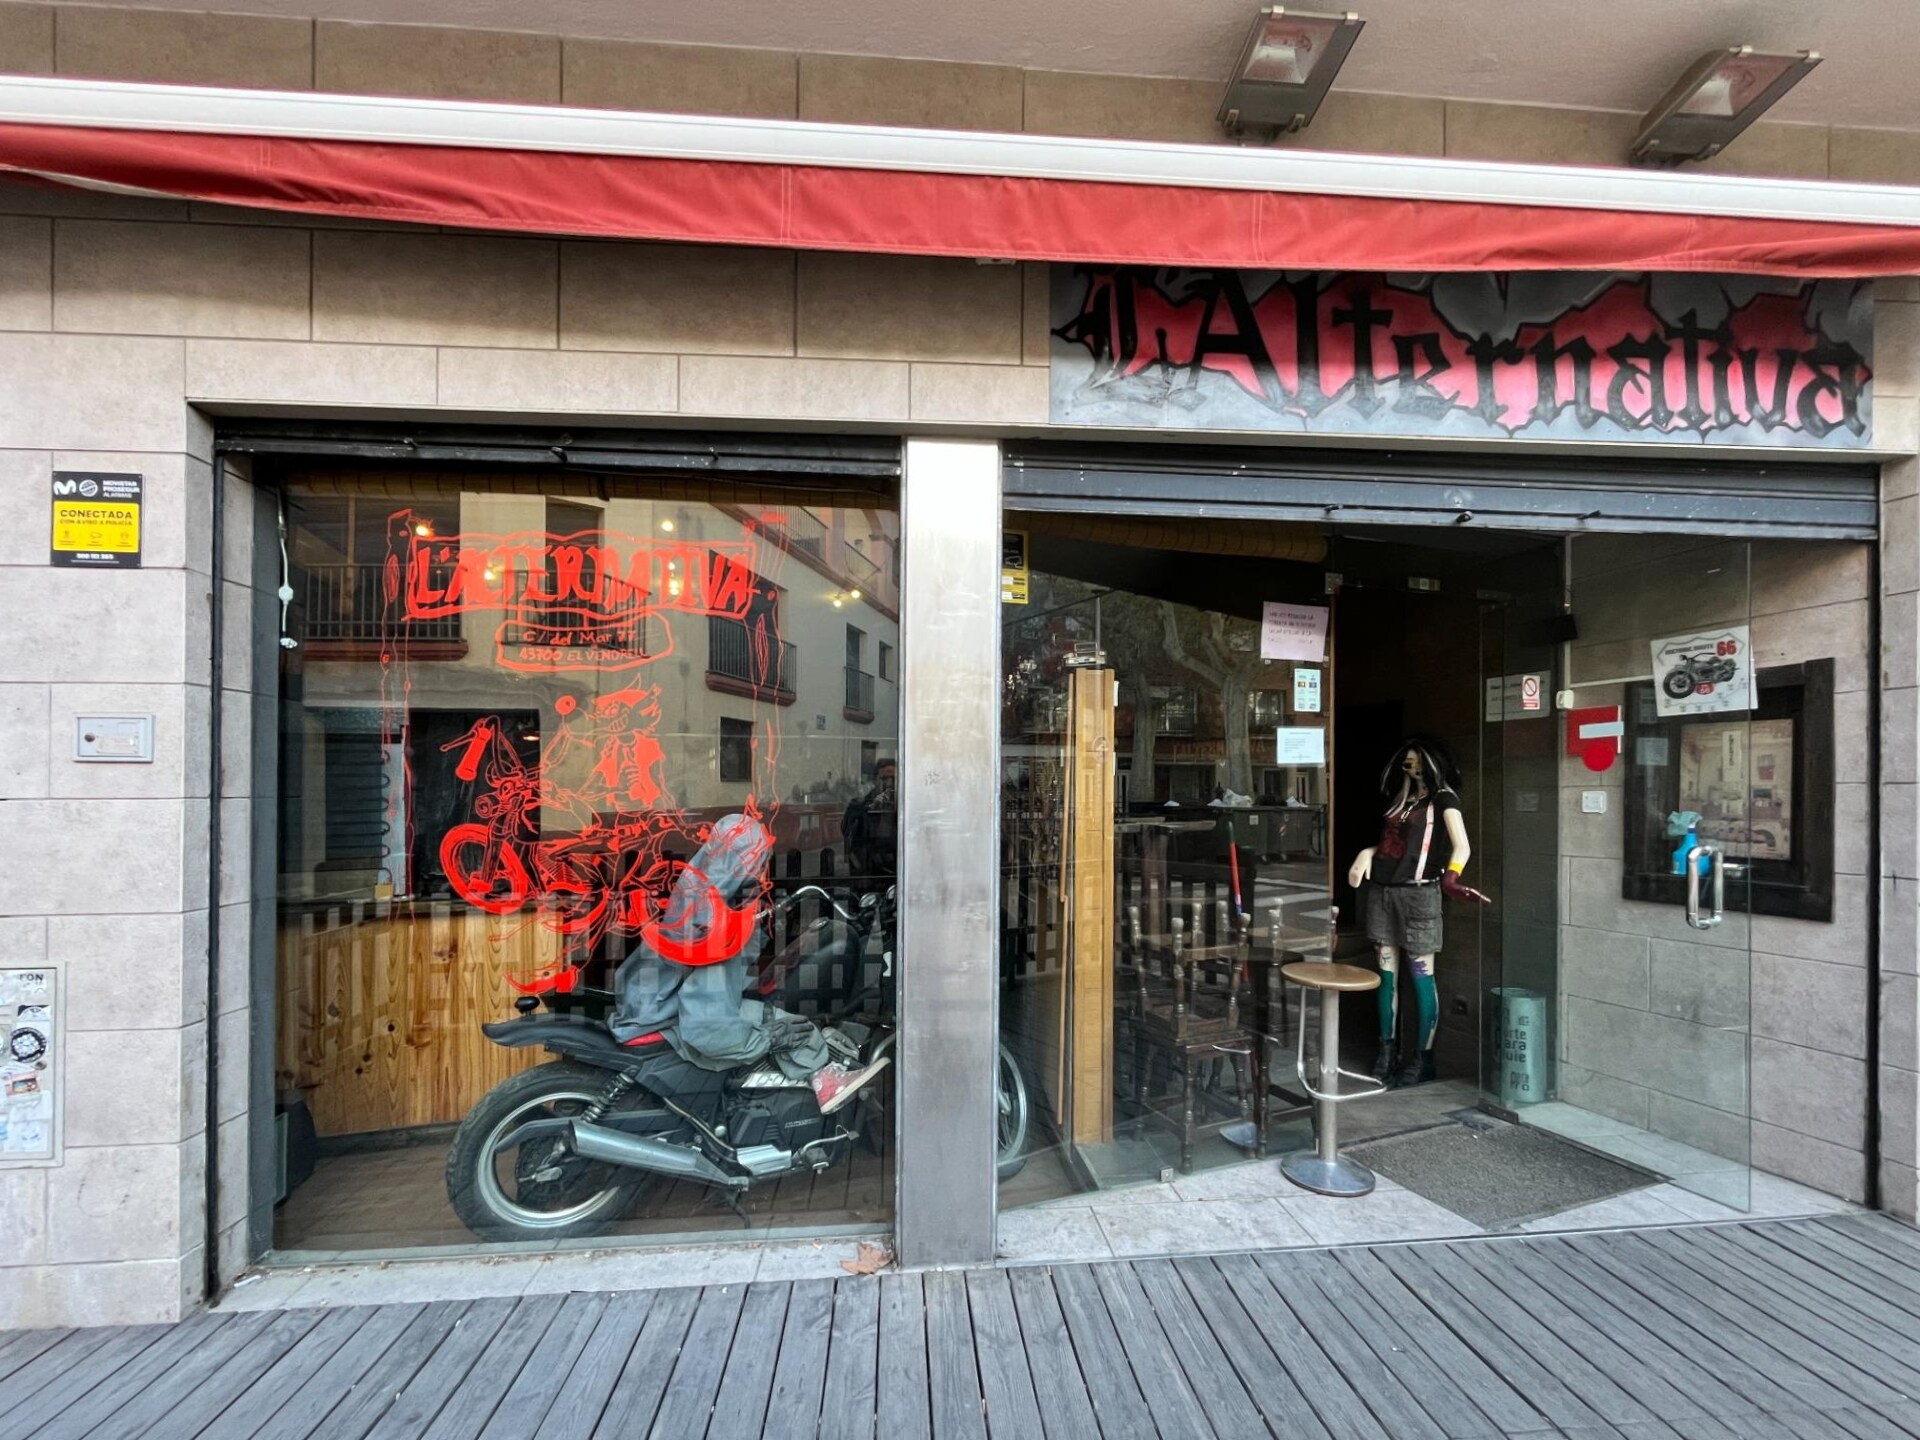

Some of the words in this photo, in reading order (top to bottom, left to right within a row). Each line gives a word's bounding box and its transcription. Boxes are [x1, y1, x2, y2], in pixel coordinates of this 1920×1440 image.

[60, 509, 132, 519] CONECTADA
[550, 632, 573, 645] del
[579, 632, 612, 644] Mar
[1716, 640, 1737, 657] 66
[567, 651, 582, 661] EL
